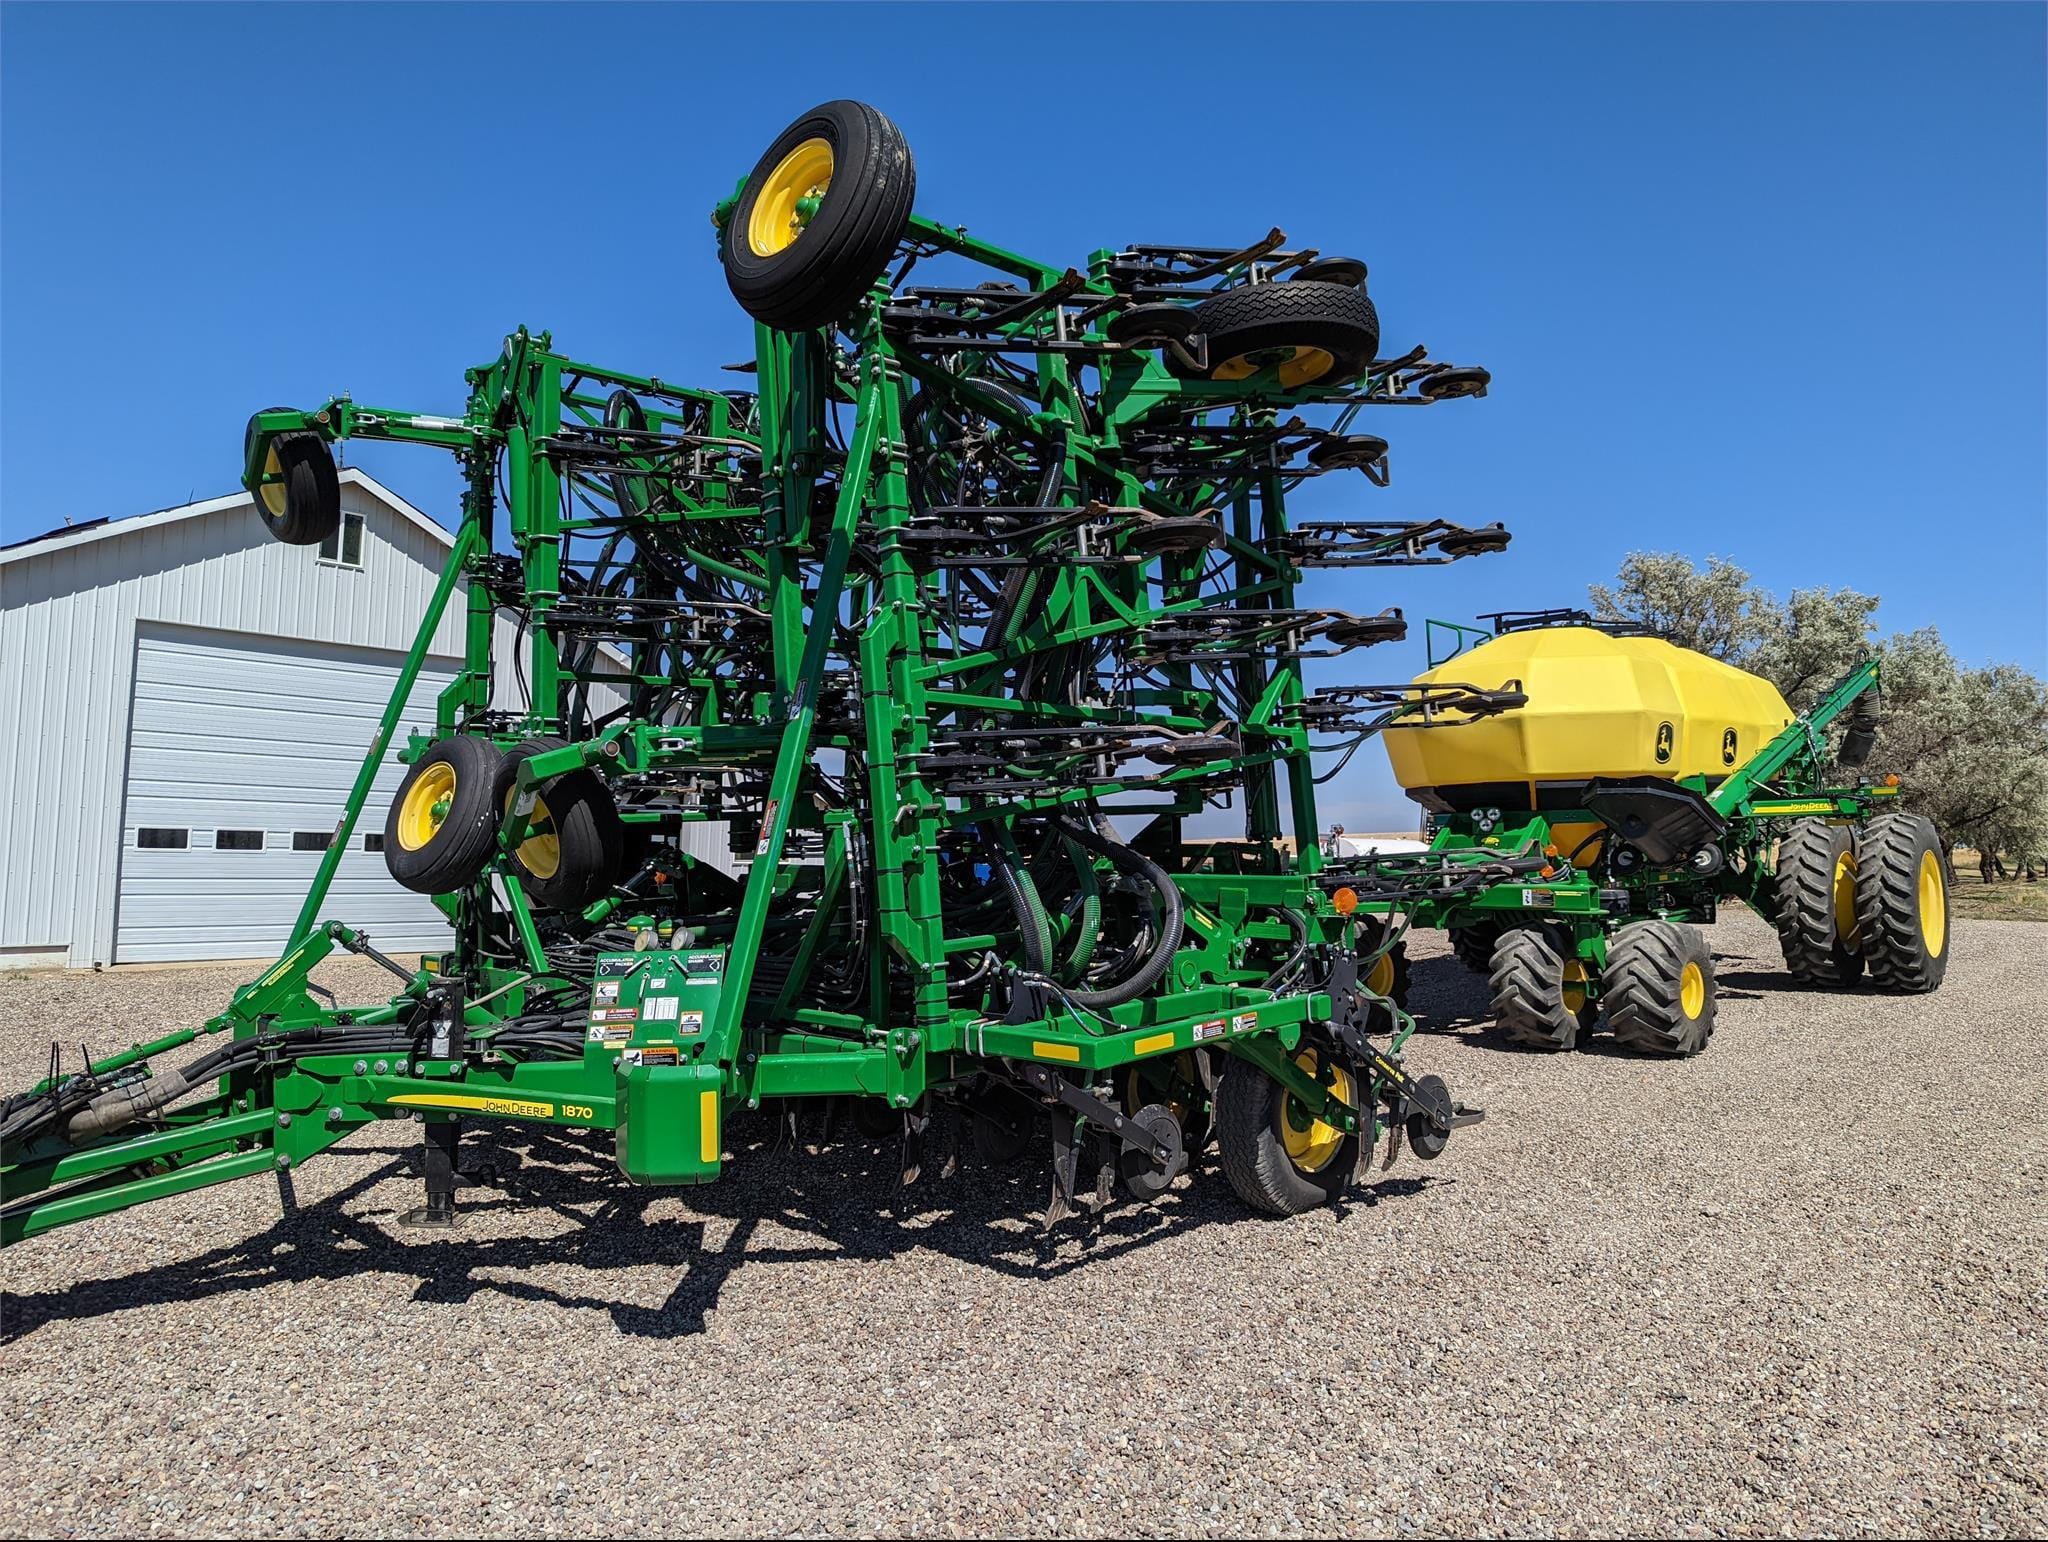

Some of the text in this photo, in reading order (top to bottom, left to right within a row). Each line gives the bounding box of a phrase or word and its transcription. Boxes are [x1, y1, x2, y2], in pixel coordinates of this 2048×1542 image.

[482, 1100, 547, 1117] JOHN DEERE
[562, 1104, 593, 1119] 1870
